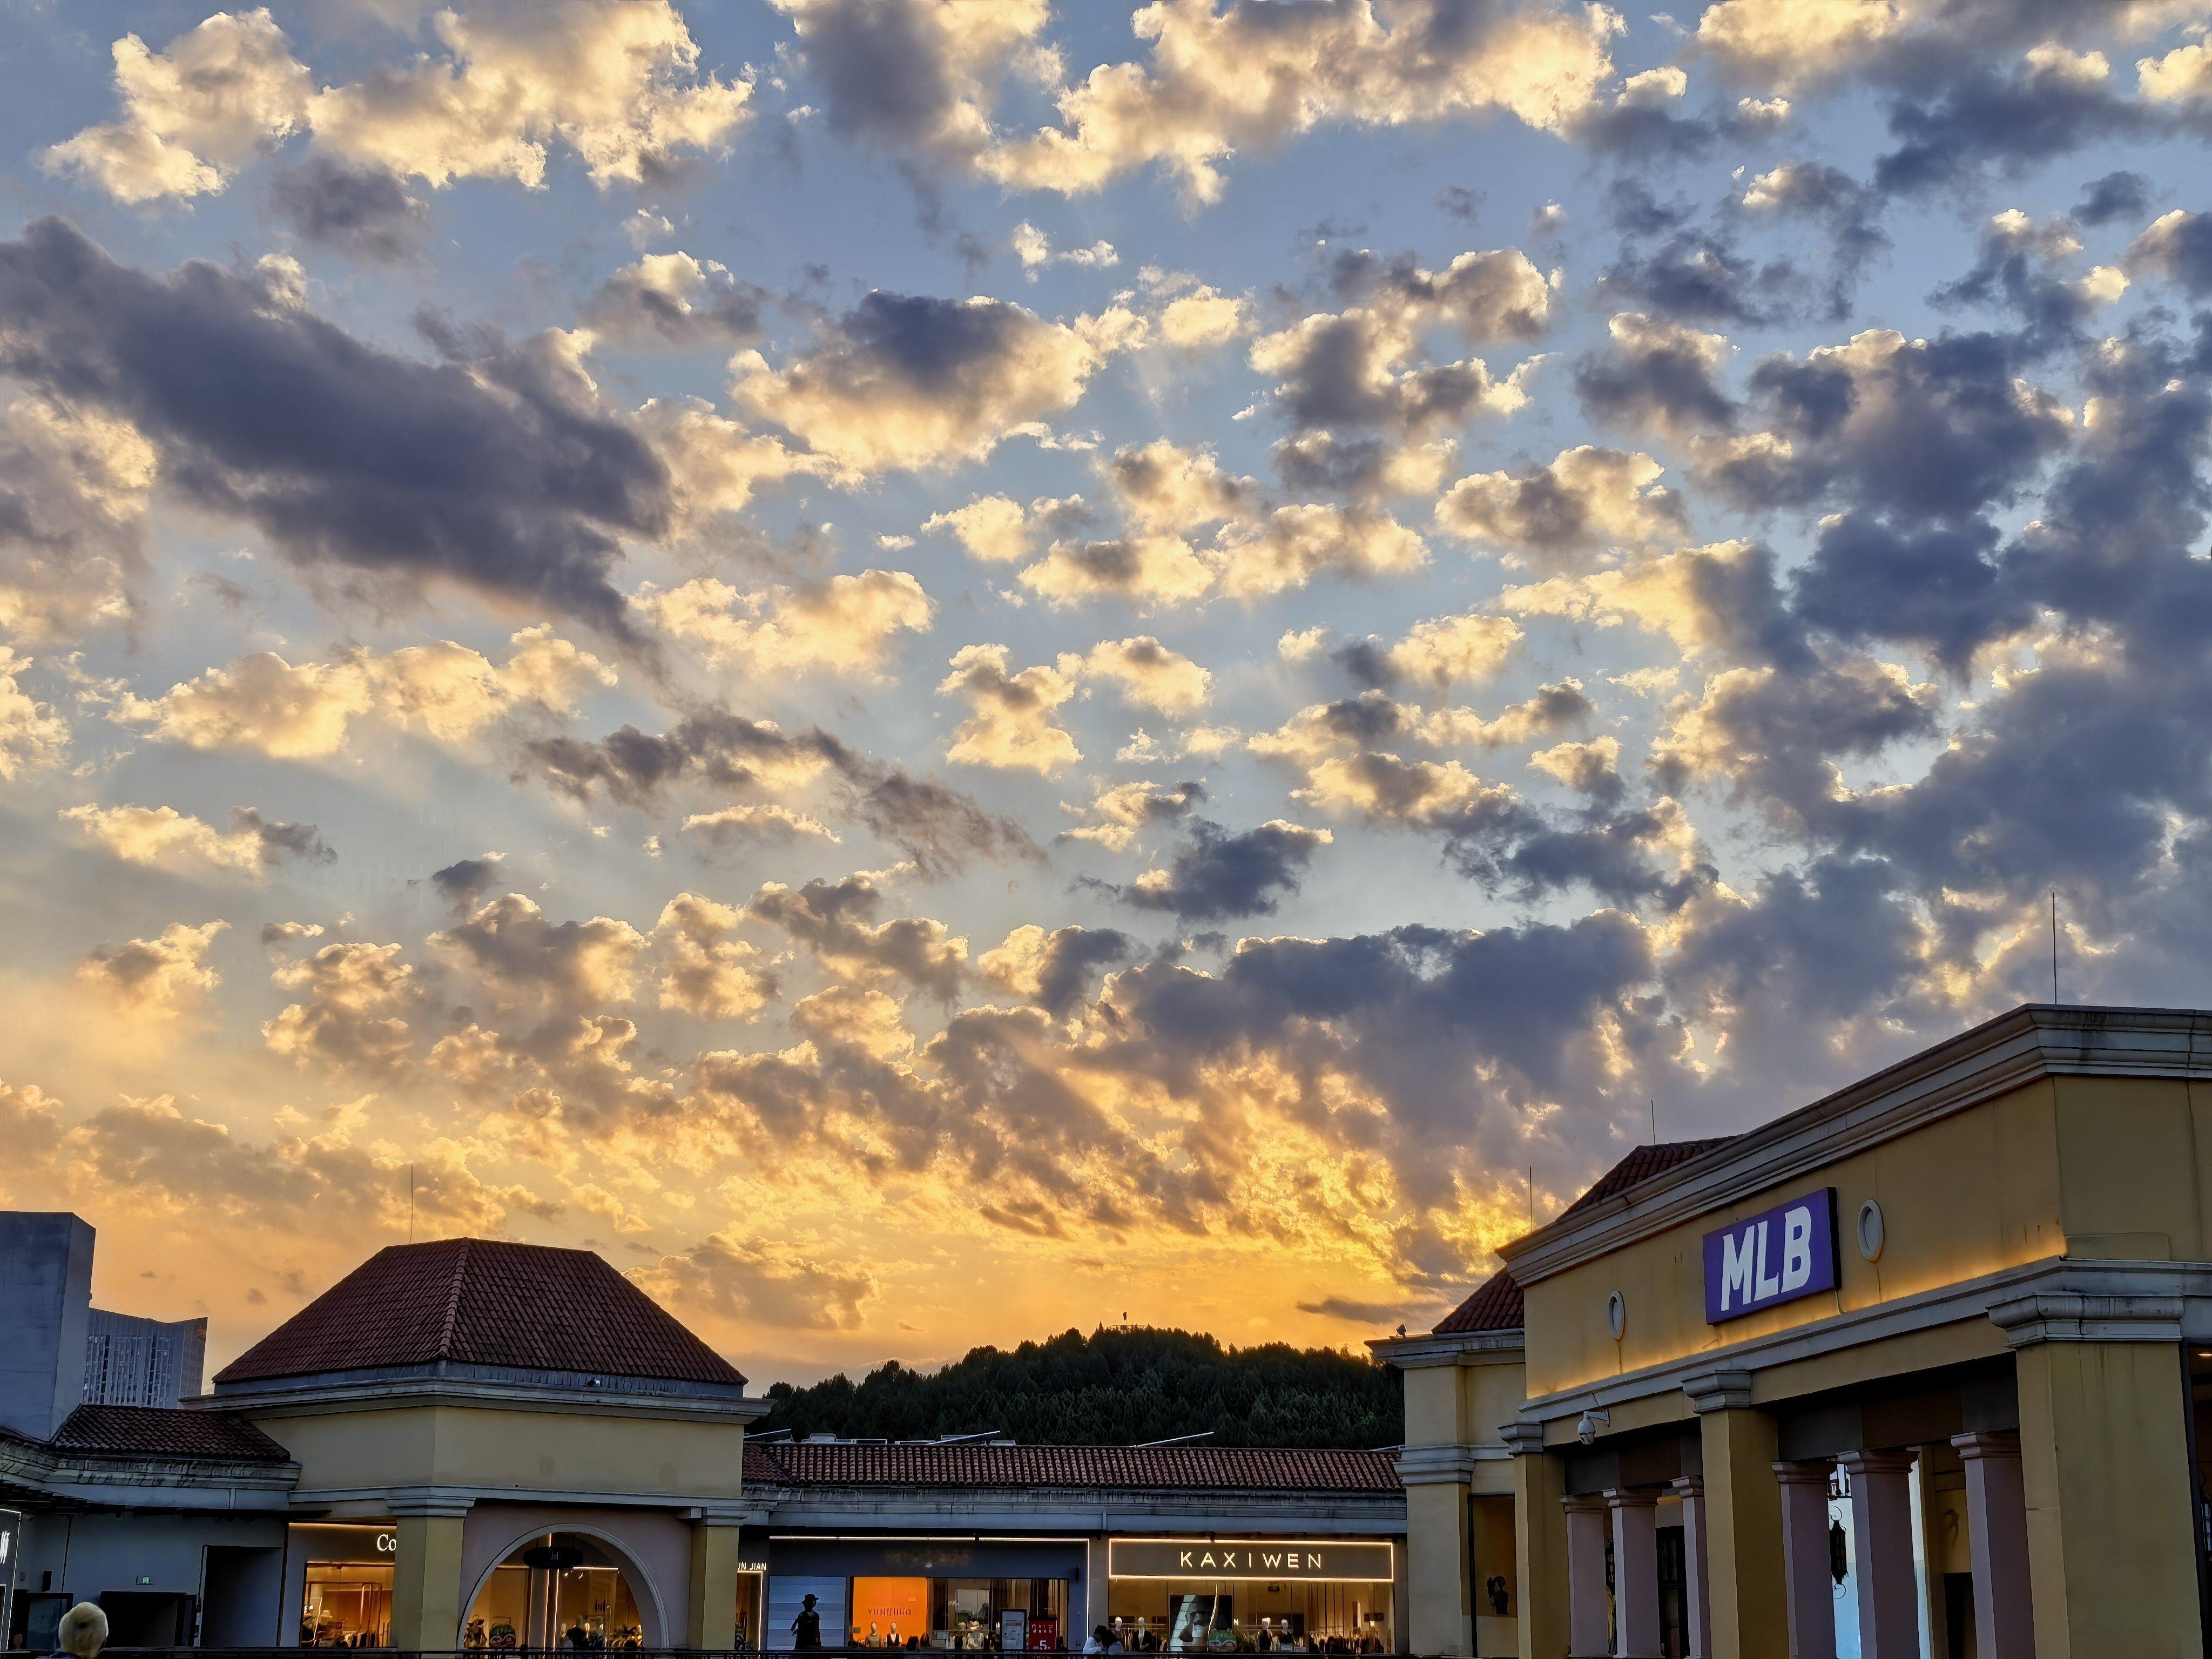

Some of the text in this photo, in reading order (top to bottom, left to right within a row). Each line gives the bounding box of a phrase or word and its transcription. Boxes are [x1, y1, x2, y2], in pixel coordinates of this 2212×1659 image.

[1721, 1206, 1811, 1311] MLB
[377, 1534, 396, 1551] Co
[749, 1562, 767, 1570] JIAN
[1181, 1552, 1321, 1569] KAXIWEN
